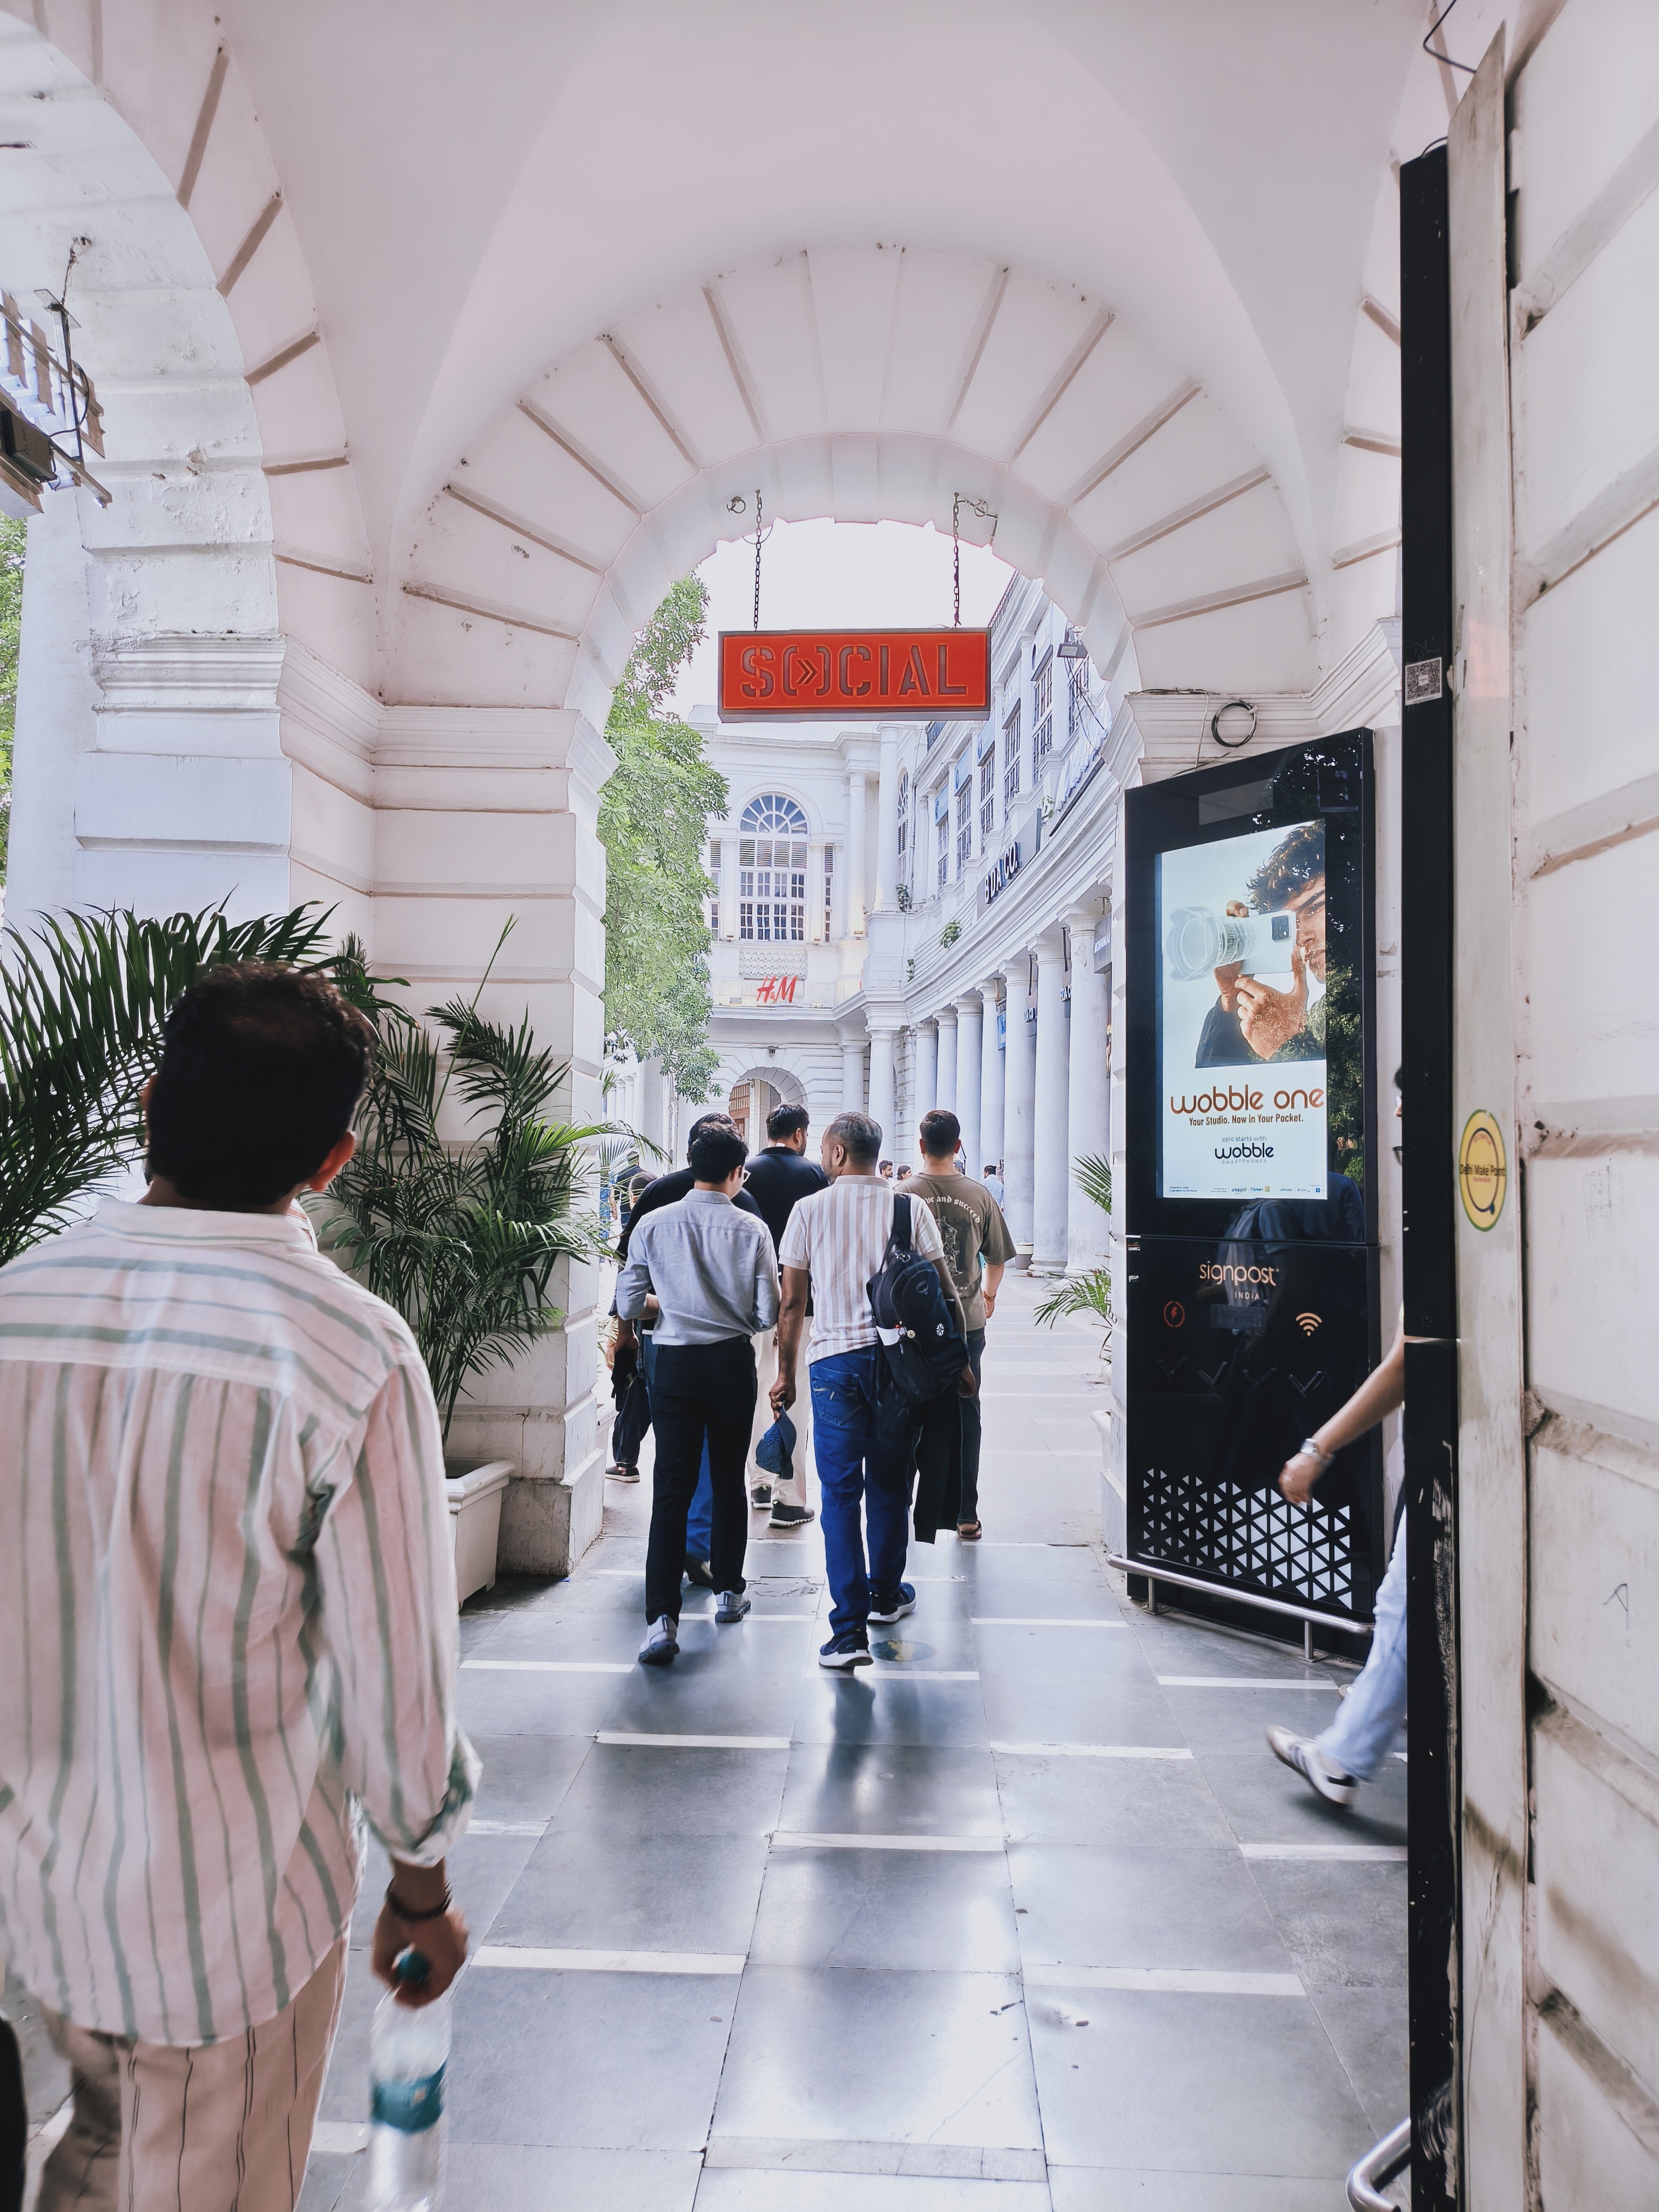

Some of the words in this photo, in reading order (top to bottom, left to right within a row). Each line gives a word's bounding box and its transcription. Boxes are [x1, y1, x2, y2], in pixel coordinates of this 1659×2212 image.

[741, 645, 967, 698] SOCIAL
[984, 859, 1005, 905] BDA
[757, 976, 798, 1004] H&M
[1170, 1084, 1264, 1114] wobble
[1274, 1088, 1324, 1109] one
[1189, 1117, 1204, 1126] Your
[1206, 1116, 1230, 1125] Studio.
[1232, 1115, 1246, 1124] Now
[1249, 1114, 1256, 1123] in
[1257, 1114, 1273, 1123] Your
[1276, 1113, 1304, 1122] Pocket.
[1215, 1143, 1274, 1159] wobble
[936, 1195, 952, 1203] and
[954, 1199, 980, 1223] succeed
[1199, 1260, 1277, 1286] signpost
[1235, 1291, 1260, 1300] INDIA
